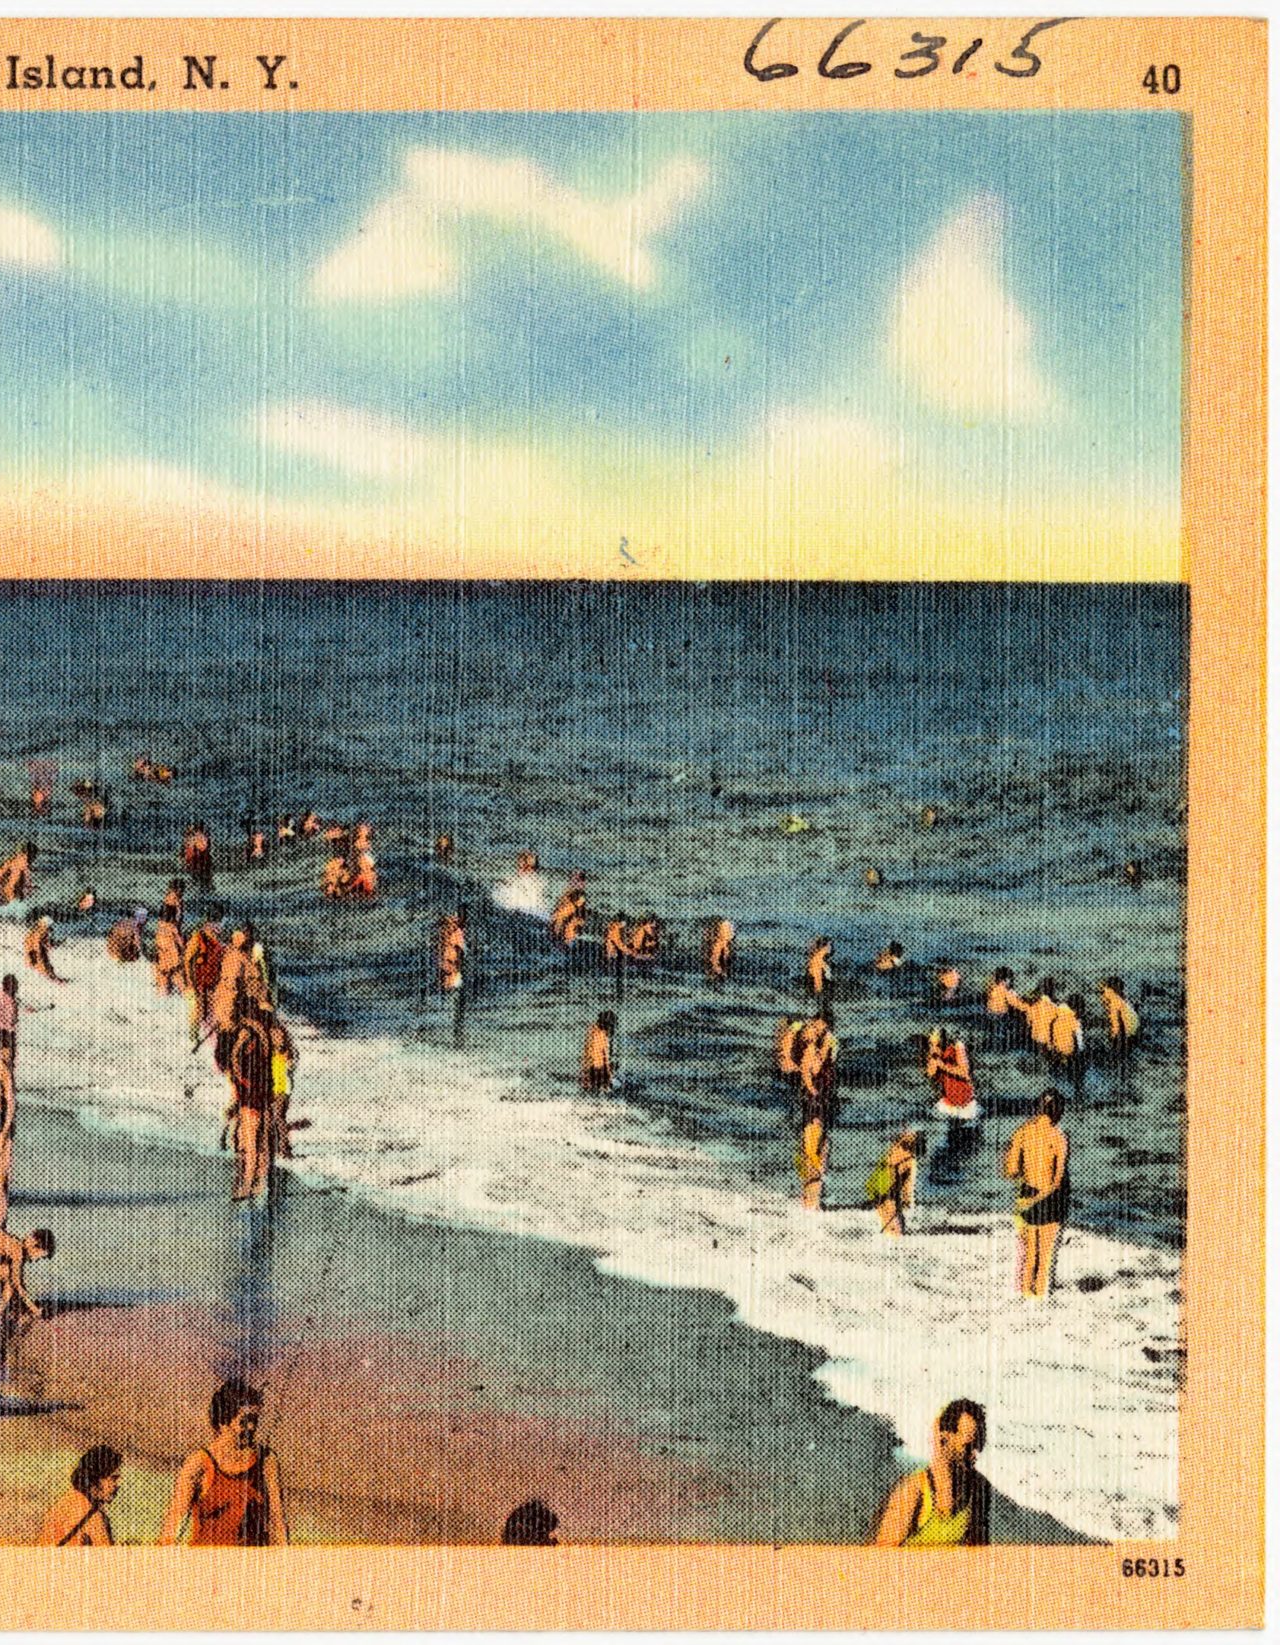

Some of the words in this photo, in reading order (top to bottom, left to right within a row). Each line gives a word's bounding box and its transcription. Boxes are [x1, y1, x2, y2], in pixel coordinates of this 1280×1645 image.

[743, 17, 1084, 82] 66315
[6, 54, 157, 92] Island,
[183, 55, 229, 90] N.
[256, 55, 299, 90] Y.
[1142, 63, 1181, 95] 40
[1122, 1557, 1186, 1578] 66315
